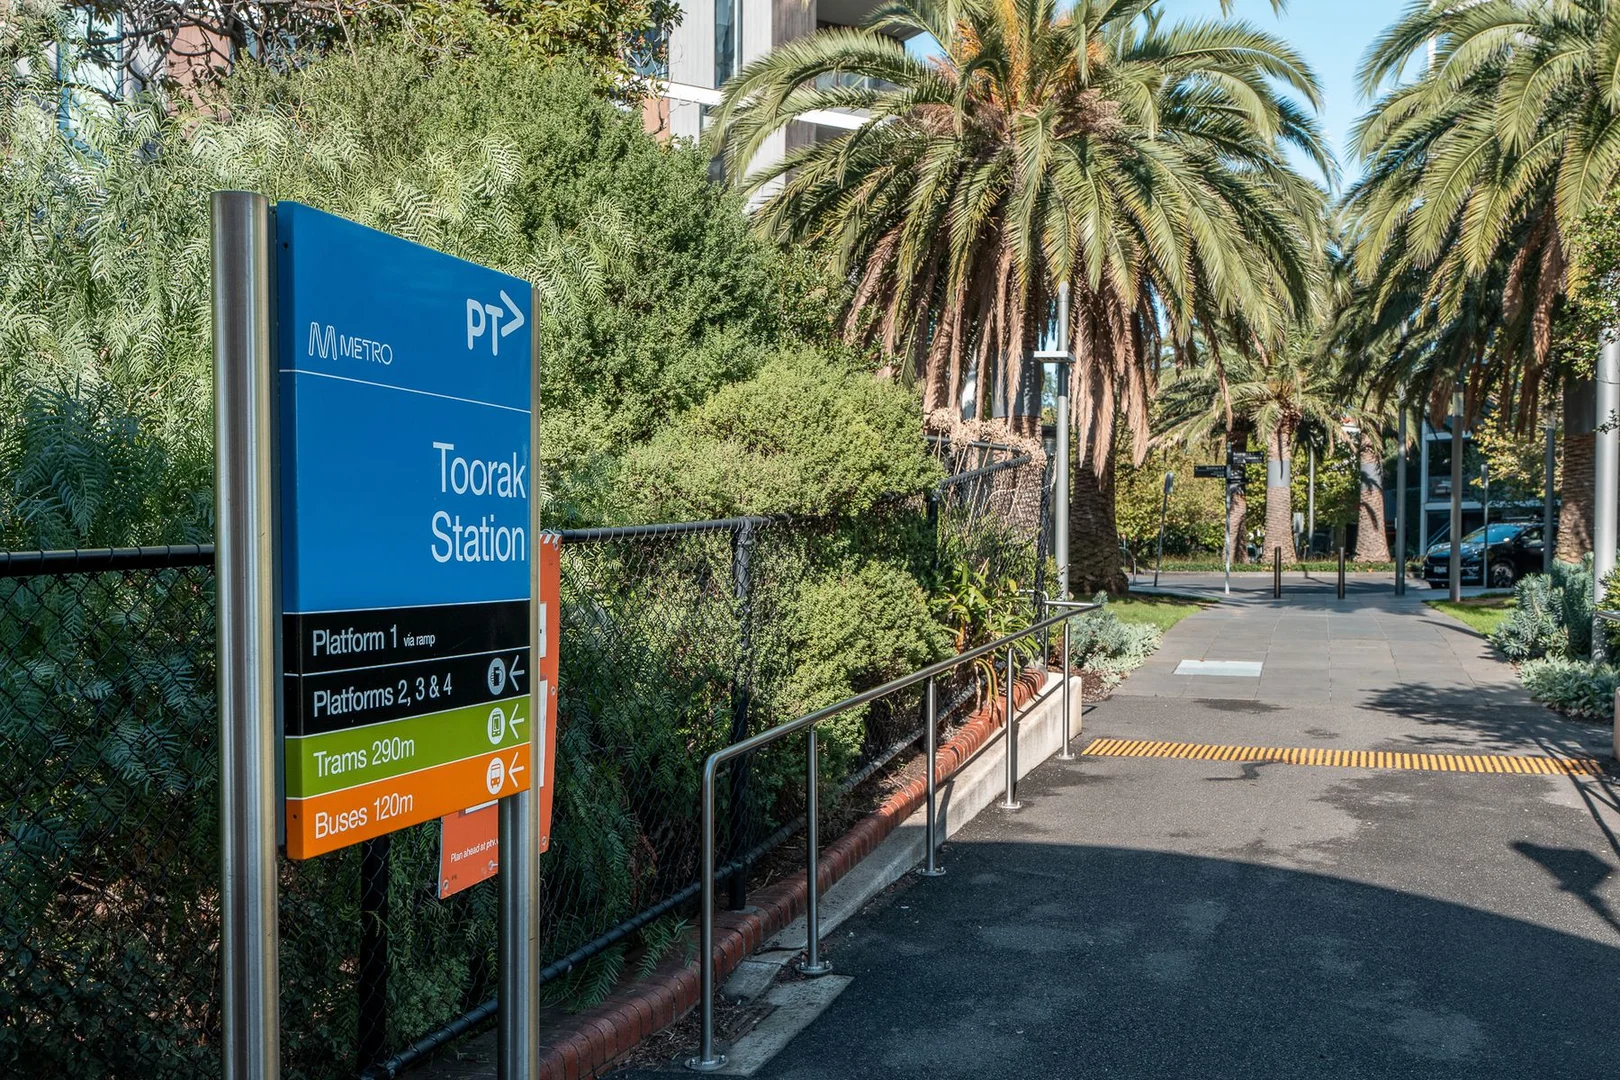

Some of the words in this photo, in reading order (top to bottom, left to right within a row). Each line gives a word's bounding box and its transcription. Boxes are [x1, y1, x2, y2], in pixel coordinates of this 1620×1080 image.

[340, 334, 393, 365] METRO
[432, 441, 526, 499] Toorak
[431, 510, 525, 563] Station
[312, 627, 385, 656] Platform
[390, 624, 397, 648] 1
[403, 634, 415, 647] via
[416, 634, 436, 647] ramp
[313, 686, 393, 718] Platforms
[397, 680, 411, 707] 2,
[415, 677, 425, 701] 3
[429, 674, 440, 698] &
[443, 672, 452, 696] 4
[313, 749, 367, 778] Trams
[372, 736, 415, 766] 290m
[315, 807, 368, 840] Buses
[373, 793, 413, 822] 120m
[450, 852, 463, 863] Plan
[463, 844, 480, 858] ahead
[480, 841, 486, 852] at
